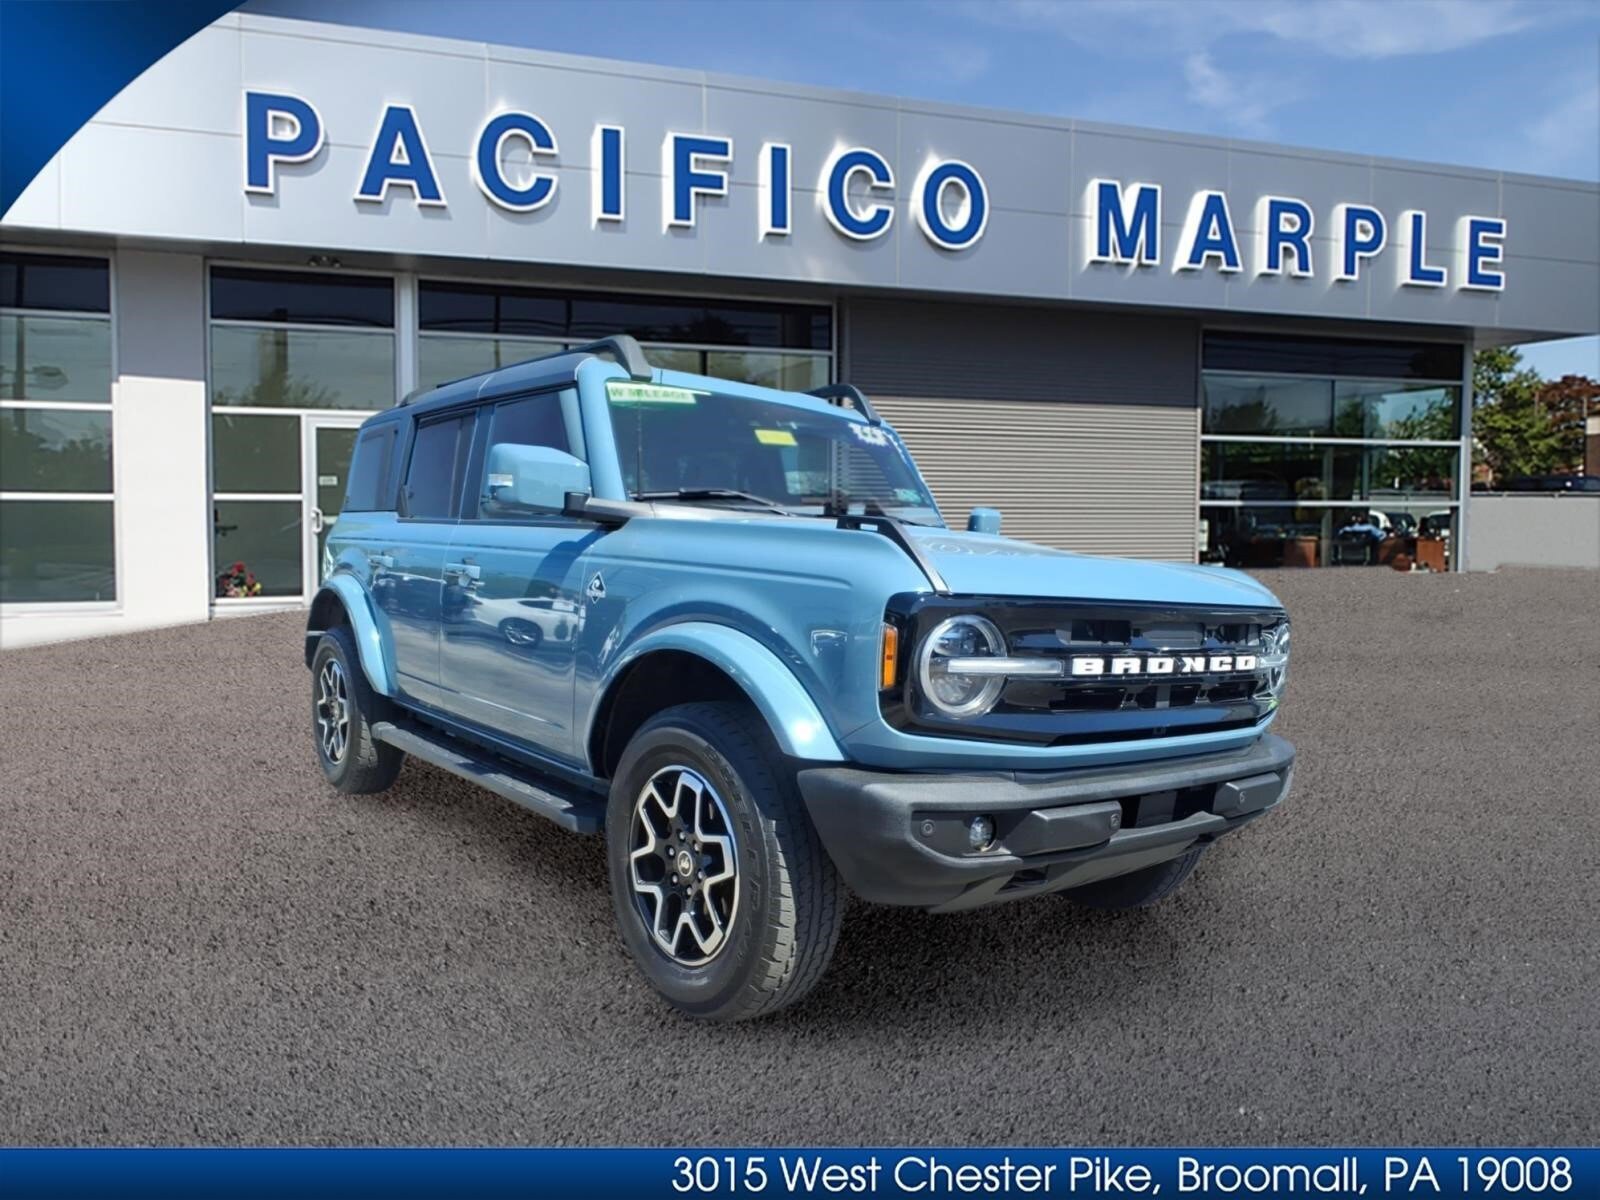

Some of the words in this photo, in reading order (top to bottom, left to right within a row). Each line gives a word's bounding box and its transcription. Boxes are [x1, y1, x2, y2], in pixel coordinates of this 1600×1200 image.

[243, 90, 989, 250] PACIFICO
[1089, 179, 1507, 291] MARPLE
[1071, 655, 1256, 676] BRONCO
